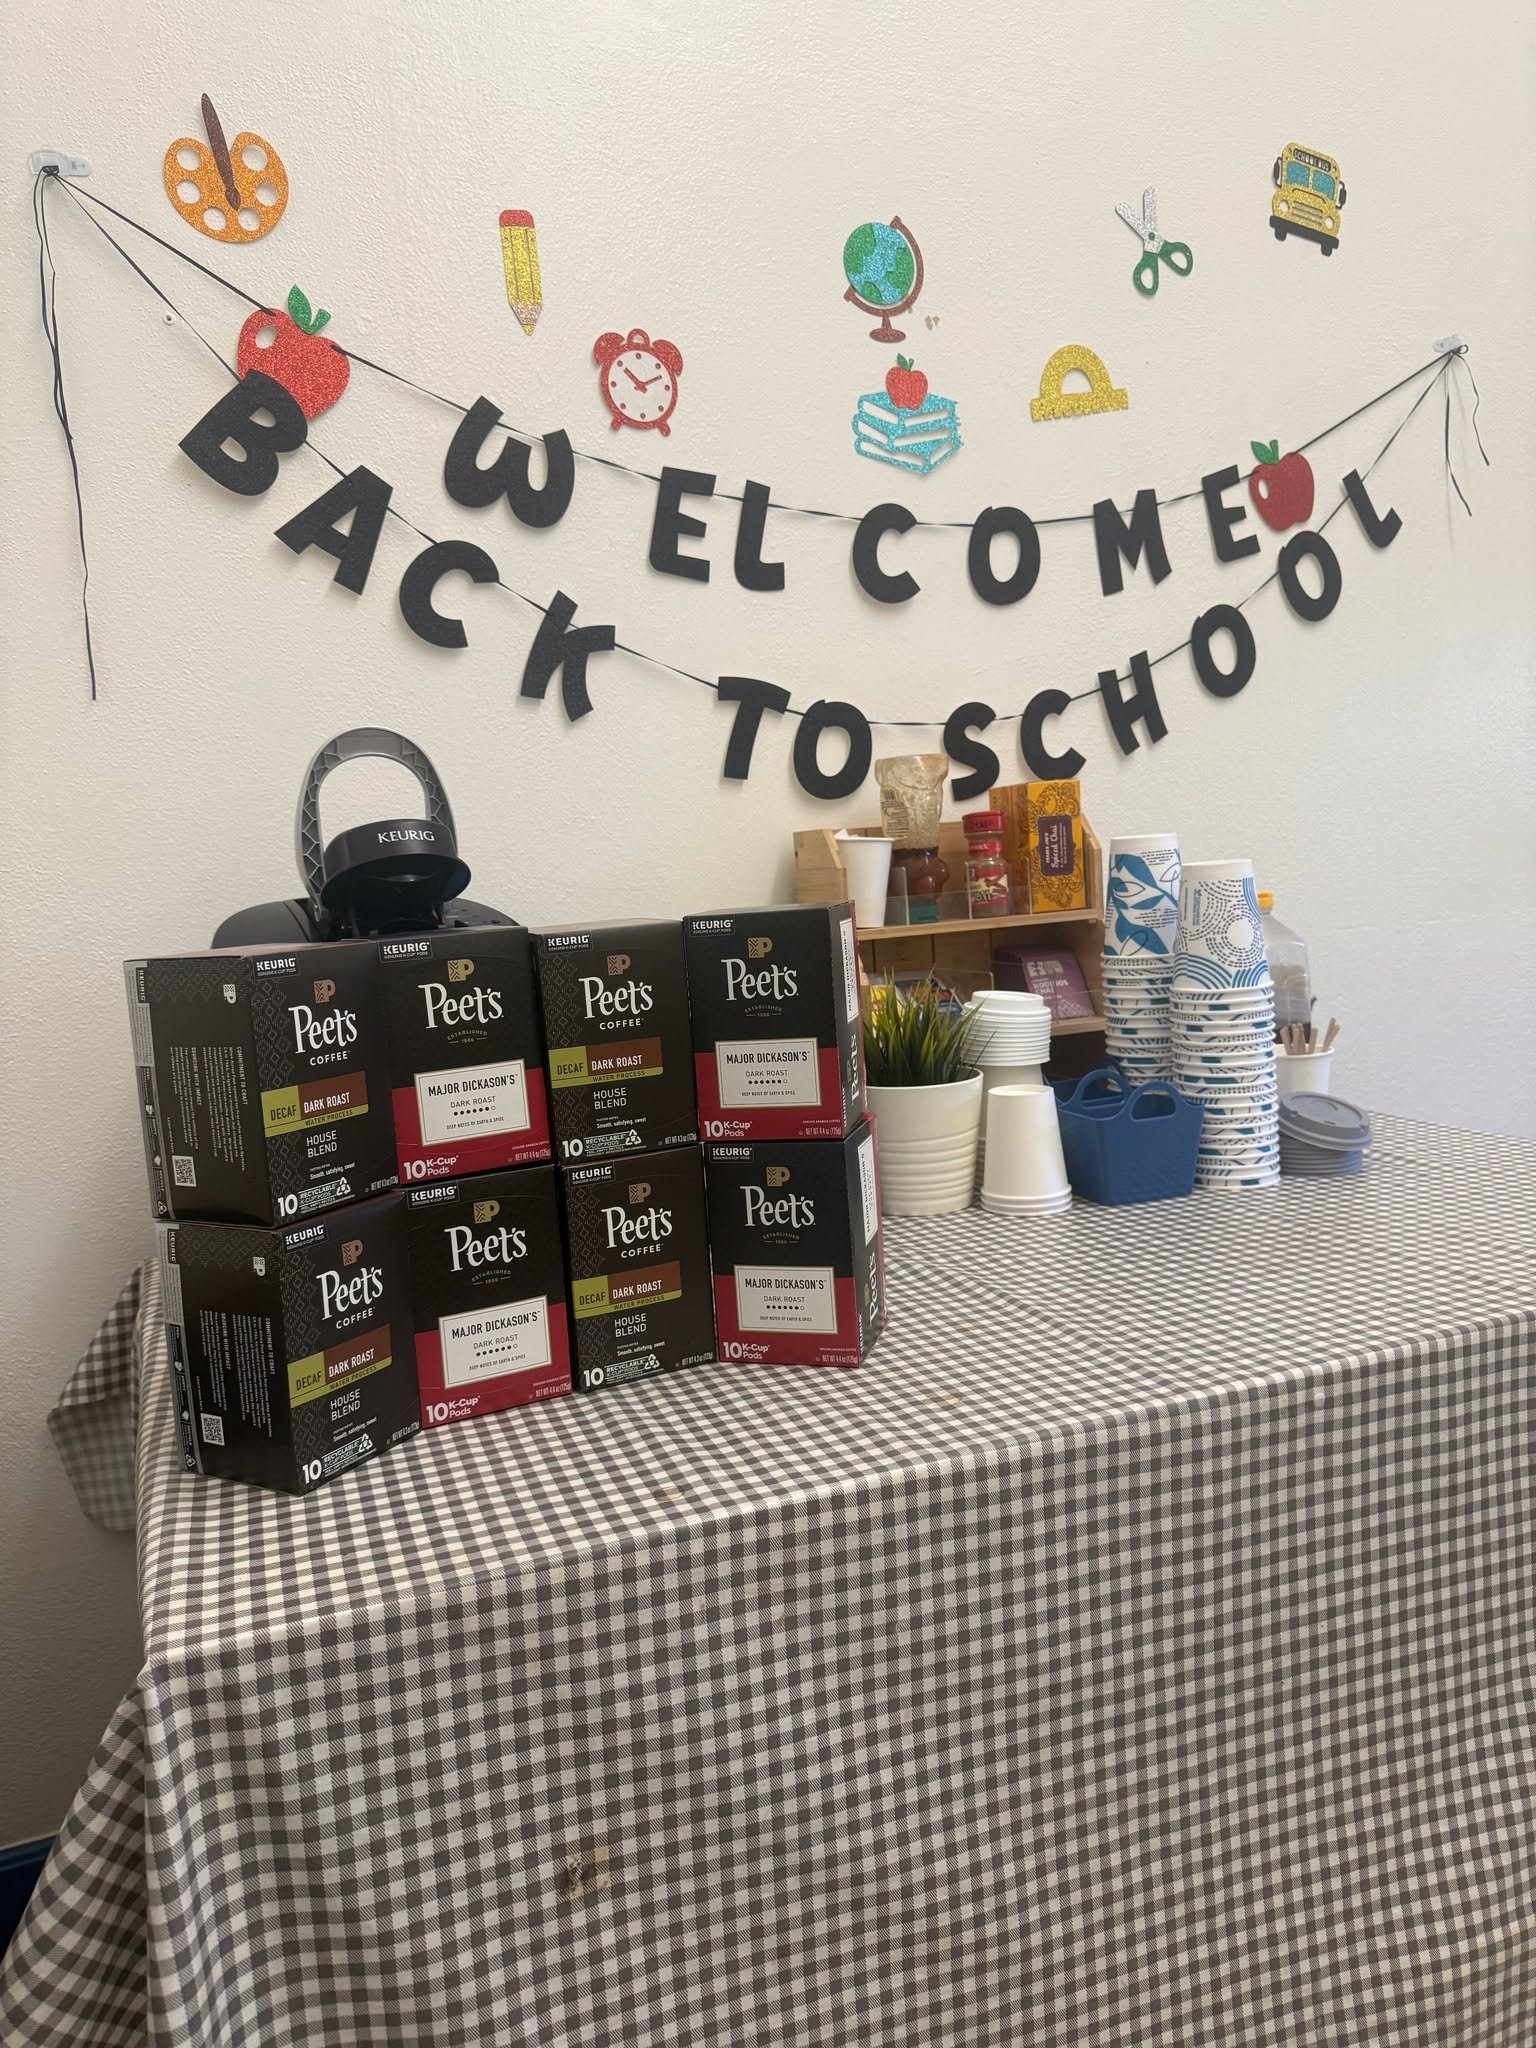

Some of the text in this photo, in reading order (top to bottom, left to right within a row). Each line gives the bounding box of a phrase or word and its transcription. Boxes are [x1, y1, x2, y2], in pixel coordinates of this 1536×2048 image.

[443, 395, 1261, 605] WELCOME
[178, 369, 1403, 801] BACK TO SCHOOL
[378, 830, 434, 843] KEURIG
[693, 920, 731, 929] KEURIG
[384, 942, 427, 954] KEURIG
[548, 936, 589, 946] KEURIG
[256, 958, 295, 971] KEURIG
[721, 959, 798, 1000] Peet's
[418, 983, 503, 1028] Peet's
[578, 977, 653, 1018] Peet's
[288, 1005, 357, 1054] Peet's
[600, 1018, 640, 1030] COFFEE
[310, 1051, 348, 1065] COFFEE
[592, 1055, 642, 1071] DARK ROAST
[727, 1051, 807, 1064] MAJOR DICKASON'S
[557, 1063, 584, 1075] DECAF
[593, 1071, 645, 1082] WATER PROCESS
[428, 1075, 515, 1096] MAJOR DICKASON'S
[594, 1088, 627, 1099] HOUSE
[304, 1092, 350, 1113] DARK ROAST
[451, 1096, 496, 1108] DARK ROAST
[594, 1098, 627, 1110] BLEND
[270, 1105, 296, 1121] DECAF
[305, 1110, 353, 1126] WATER PROCESS
[705, 1121, 723, 1137] 10
[724, 1121, 750, 1129] K-Cup
[725, 1129, 744, 1137] Pods
[306, 1130, 337, 1146] HOUSE
[307, 1142, 337, 1158] BLEND
[562, 1139, 583, 1157] 10
[713, 1148, 750, 1156] KEURIG
[404, 1160, 426, 1179] 10
[427, 1156, 456, 1167] K-Cup
[428, 1166, 449, 1176] Pods
[572, 1166, 611, 1180] KEURIG
[411, 1186, 455, 1201] KEURIG
[278, 1194, 297, 1217] 10
[740, 1186, 814, 1228] Peet's
[285, 1225, 324, 1244] KEURIG
[601, 1206, 672, 1248] Peet's
[444, 1226, 527, 1271] Peet's
[621, 1244, 661, 1258] COFFEE
[613, 1280, 661, 1299] DARK ROAST
[745, 1278, 824, 1289] MAJOR DICKASON'S
[316, 1267, 383, 1320] Peet's
[580, 1292, 605, 1305] DECAF
[614, 1295, 664, 1310] WATER PROCESS
[336, 1308, 373, 1329] COFFEE
[452, 1312, 538, 1339] MAJOR DICKASON'S
[615, 1313, 646, 1327] HOUSE
[615, 1324, 647, 1337] BLEND
[474, 1334, 518, 1349] DARK ROAST
[742, 1344, 769, 1352] K-Cup
[723, 1342, 742, 1358] 10
[743, 1351, 762, 1359] Pods
[328, 1348, 374, 1377] DARK ROAST
[296, 1371, 322, 1390] DECAF
[330, 1365, 376, 1389] WATER PROCESS
[583, 1368, 604, 1386] 10
[330, 1389, 360, 1410] HOUSE
[449, 1397, 478, 1408] K-Cup
[332, 1400, 360, 1421] BLEND
[426, 1403, 448, 1423] 10
[450, 1407, 471, 1418] Pods
[302, 1460, 322, 1484] 10
